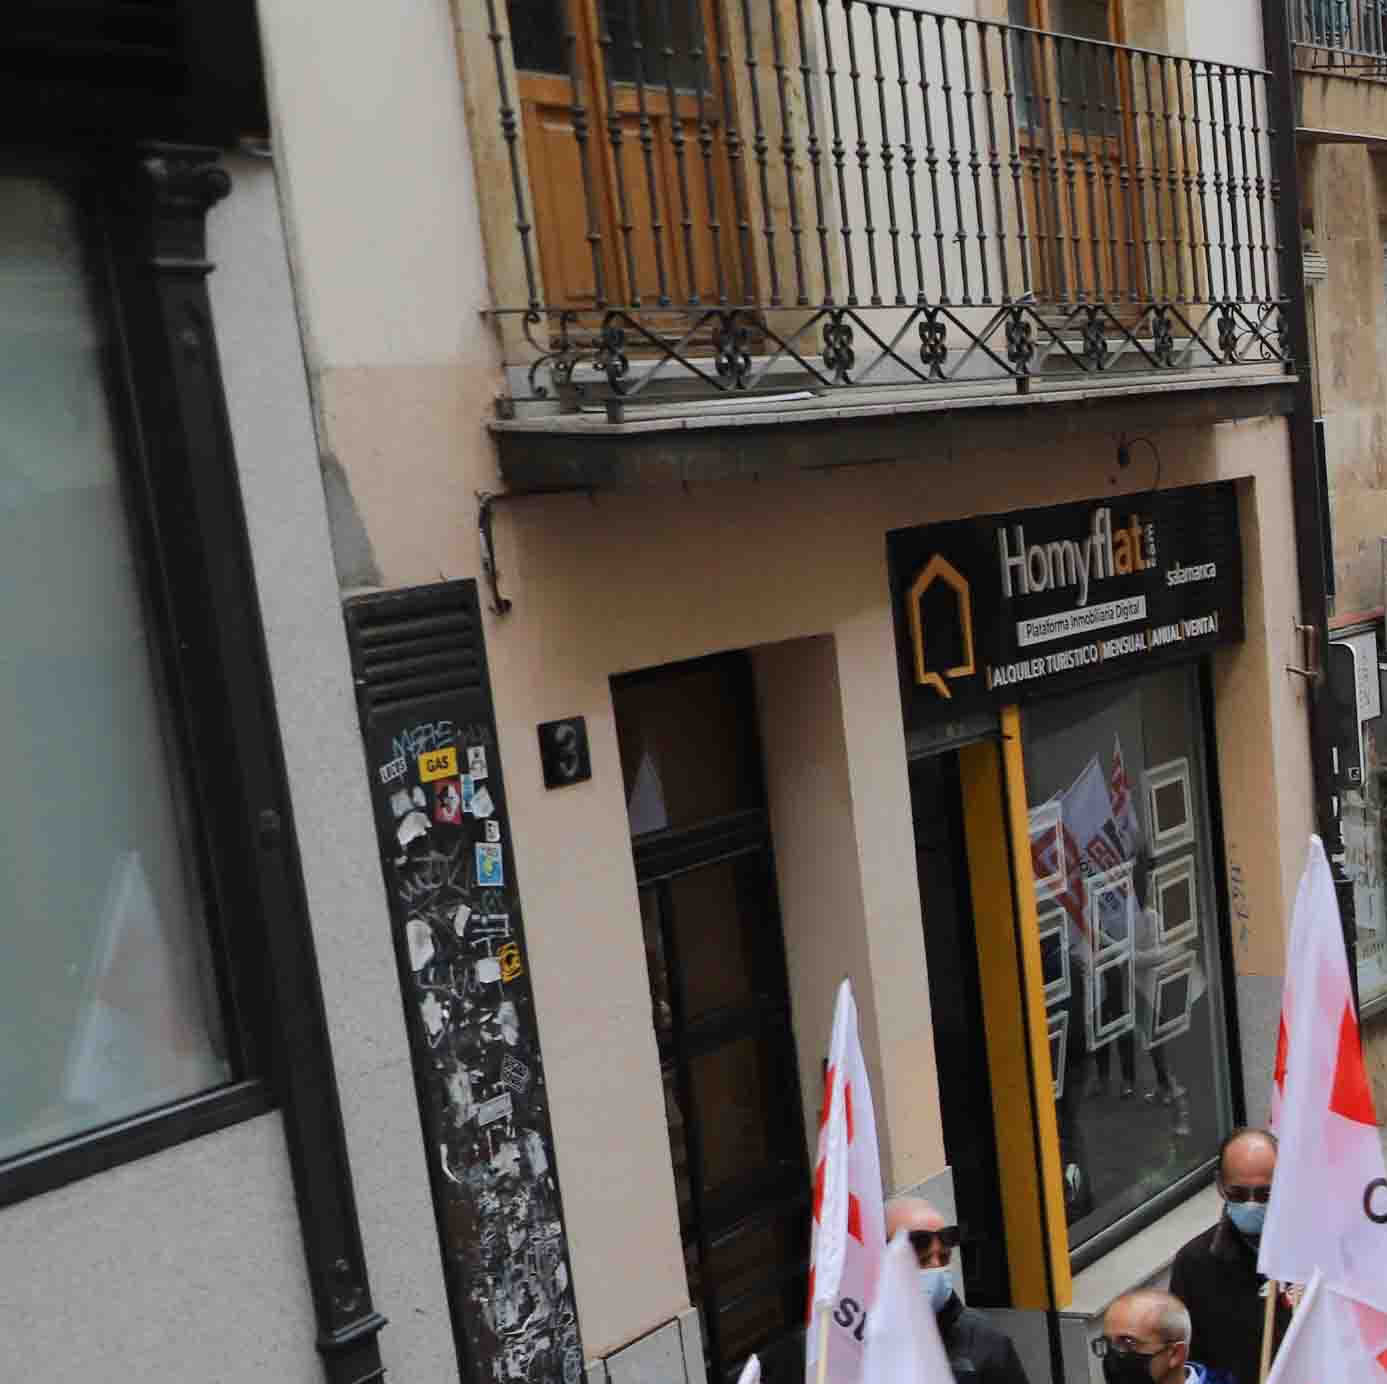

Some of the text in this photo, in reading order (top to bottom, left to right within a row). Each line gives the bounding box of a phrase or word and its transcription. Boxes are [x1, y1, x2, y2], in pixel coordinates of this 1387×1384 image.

[999, 506, 1147, 606] Homyflat
[1026, 615, 1070, 639] Plataforma
[992, 659, 1045, 687] ALQUILER
[426, 756, 449, 772] GAS
